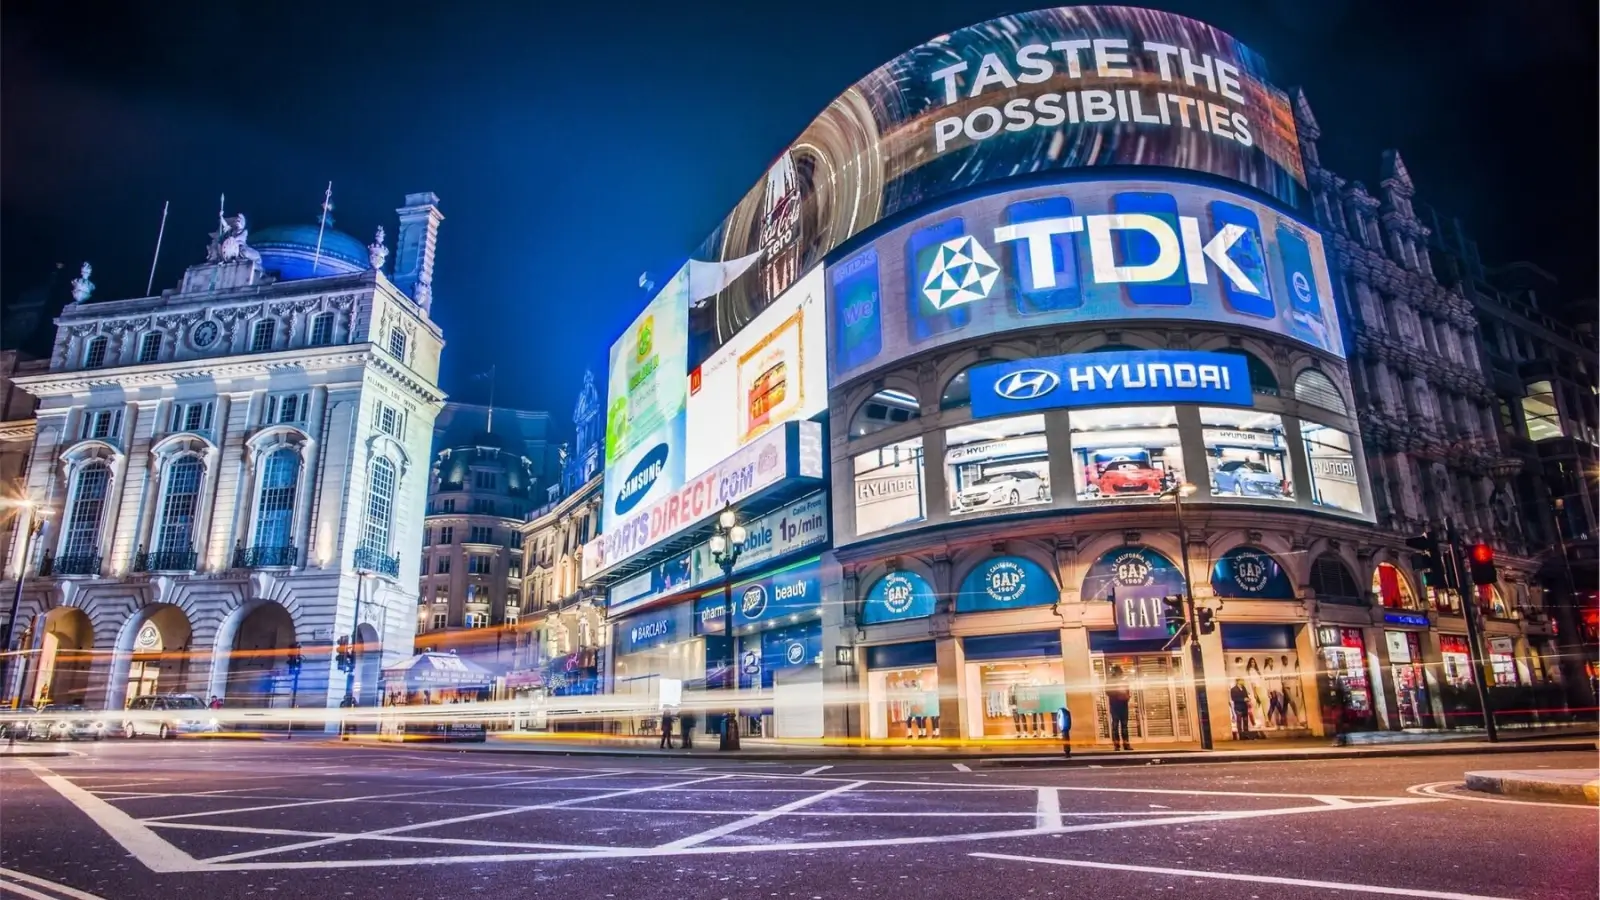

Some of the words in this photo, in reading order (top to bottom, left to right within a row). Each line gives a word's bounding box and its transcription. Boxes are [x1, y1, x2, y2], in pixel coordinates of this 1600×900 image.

[931, 39, 1133, 105] TASTE
[1143, 40, 1246, 106] THE
[934, 89, 1254, 153] POSSIBILITIES
[767, 229, 792, 260] zero
[994, 213, 1260, 294] TDK
[1070, 363, 1230, 392] HYUNDAI
[1220, 431, 1256, 440] HYUNDAI
[621, 459, 661, 501] SAMSUNG
[992, 572, 1020, 589] GAP
[1119, 563, 1148, 580] GAP
[1239, 562, 1262, 578] GAP
[775, 579, 807, 601] beauty
[888, 586, 909, 602] GAP
[1125, 597, 1162, 628] GAP
[638, 620, 667, 640] BARCLAYS
